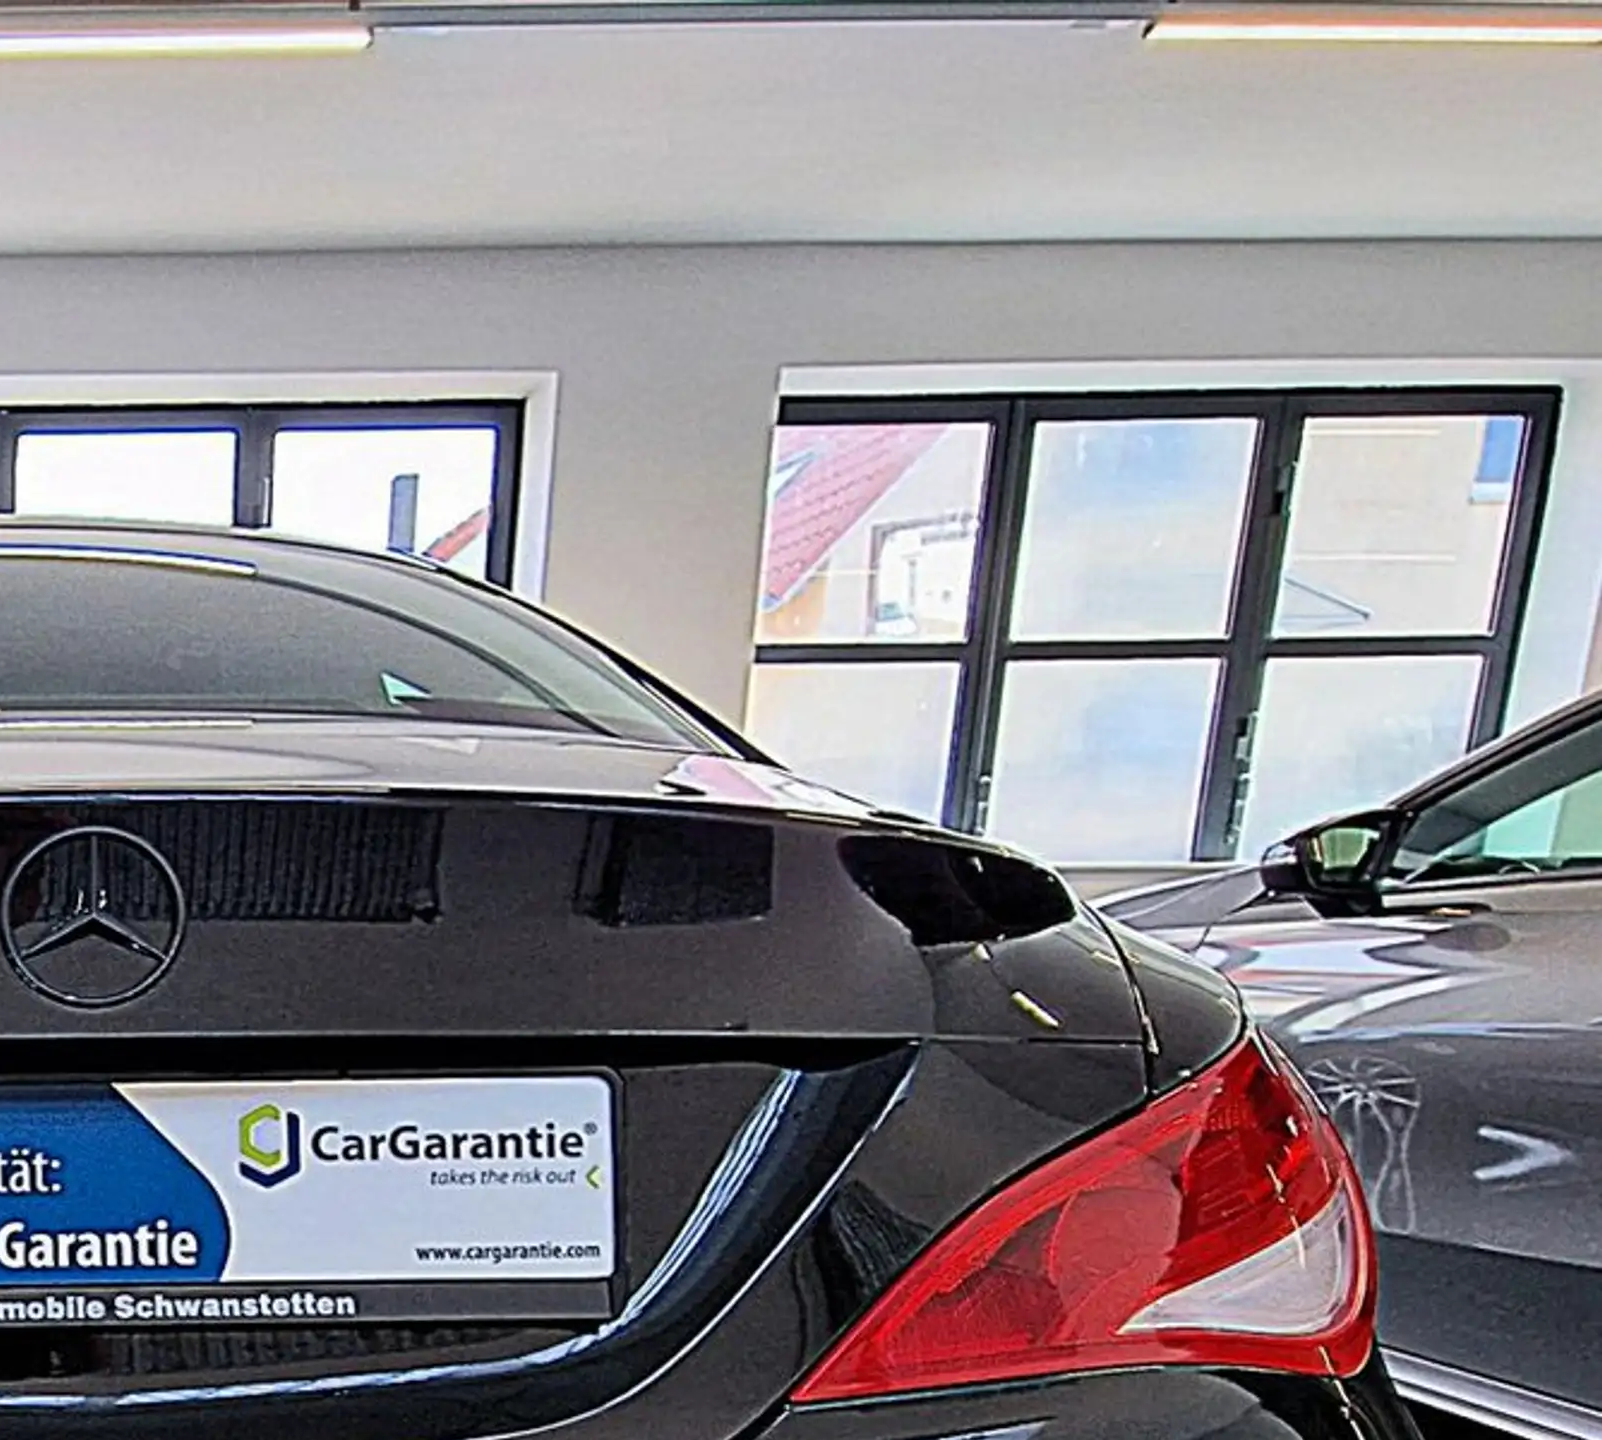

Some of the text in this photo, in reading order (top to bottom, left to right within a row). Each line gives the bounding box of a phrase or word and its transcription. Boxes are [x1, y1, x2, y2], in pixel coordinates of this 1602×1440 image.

[430, 1167, 577, 1186] takes the risk out
[415, 1242, 601, 1265] www.cargarantie.com
[113, 1292, 356, 1320] Schwanstetten
